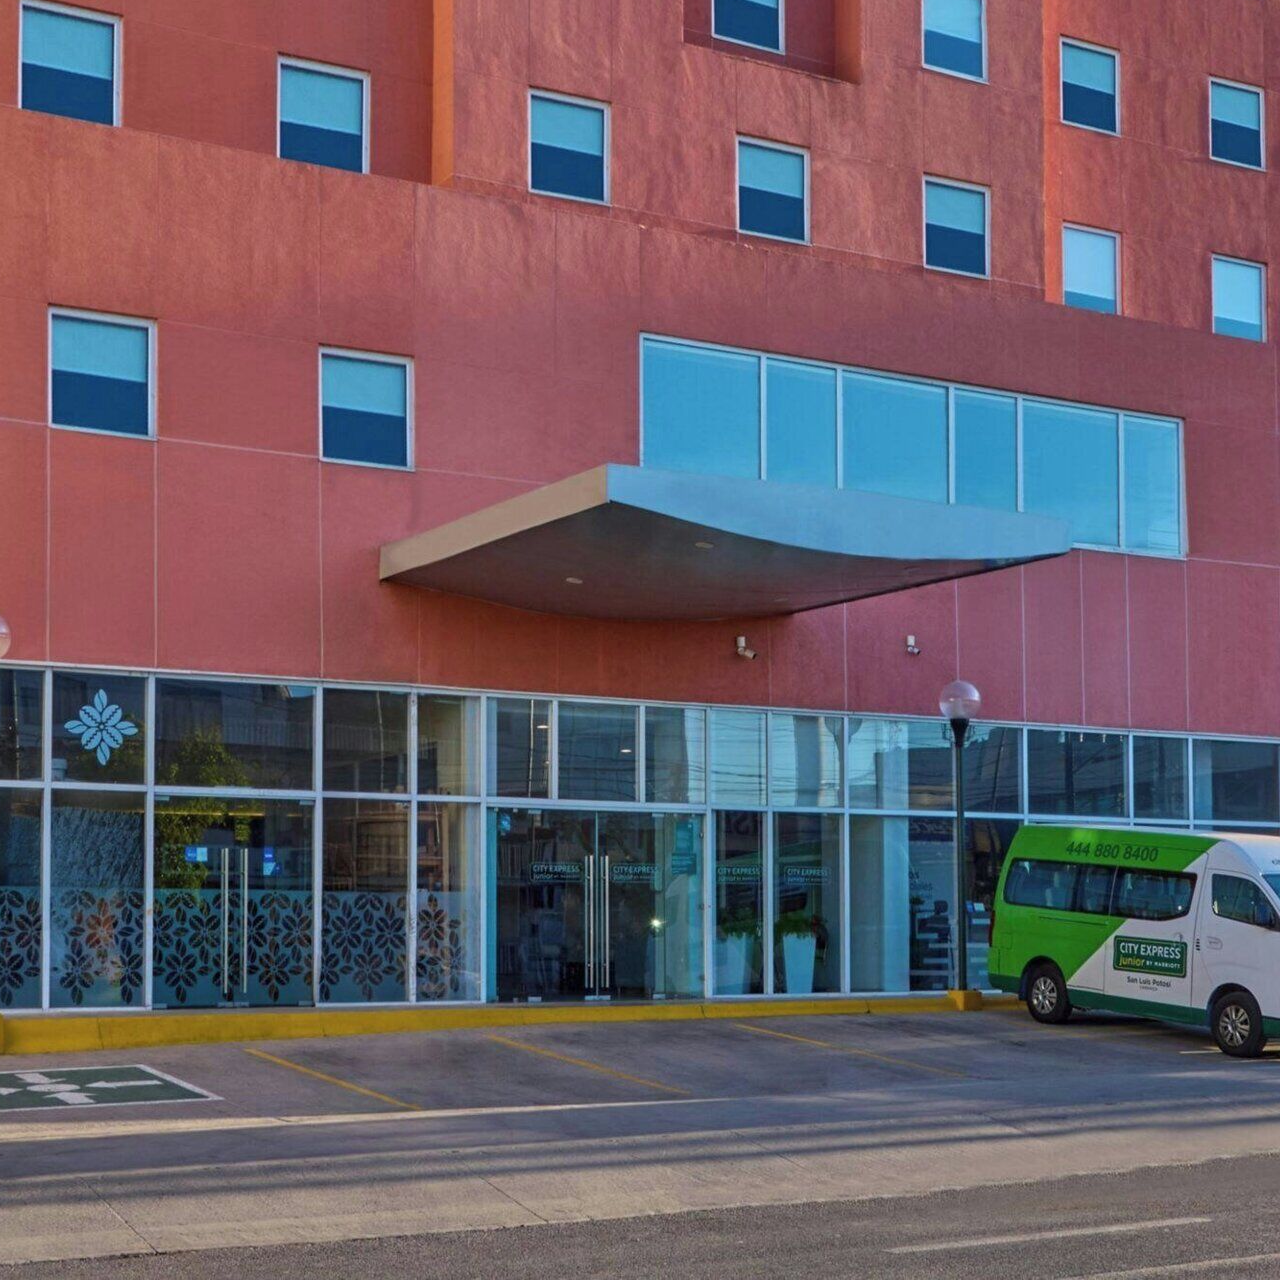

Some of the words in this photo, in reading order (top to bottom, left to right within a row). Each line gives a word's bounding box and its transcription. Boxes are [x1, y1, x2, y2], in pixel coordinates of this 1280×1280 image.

[1065, 841, 1091, 857] 444
[1094, 843, 1120, 859] 880
[1123, 845, 1159, 862] 8400
[1120, 942, 1138, 954] CITY
[1140, 944, 1181, 959] EXPRESS
[1119, 955, 1145, 967] junior
[1127, 976, 1138, 984] San
[1139, 977, 1151, 986] Luis
